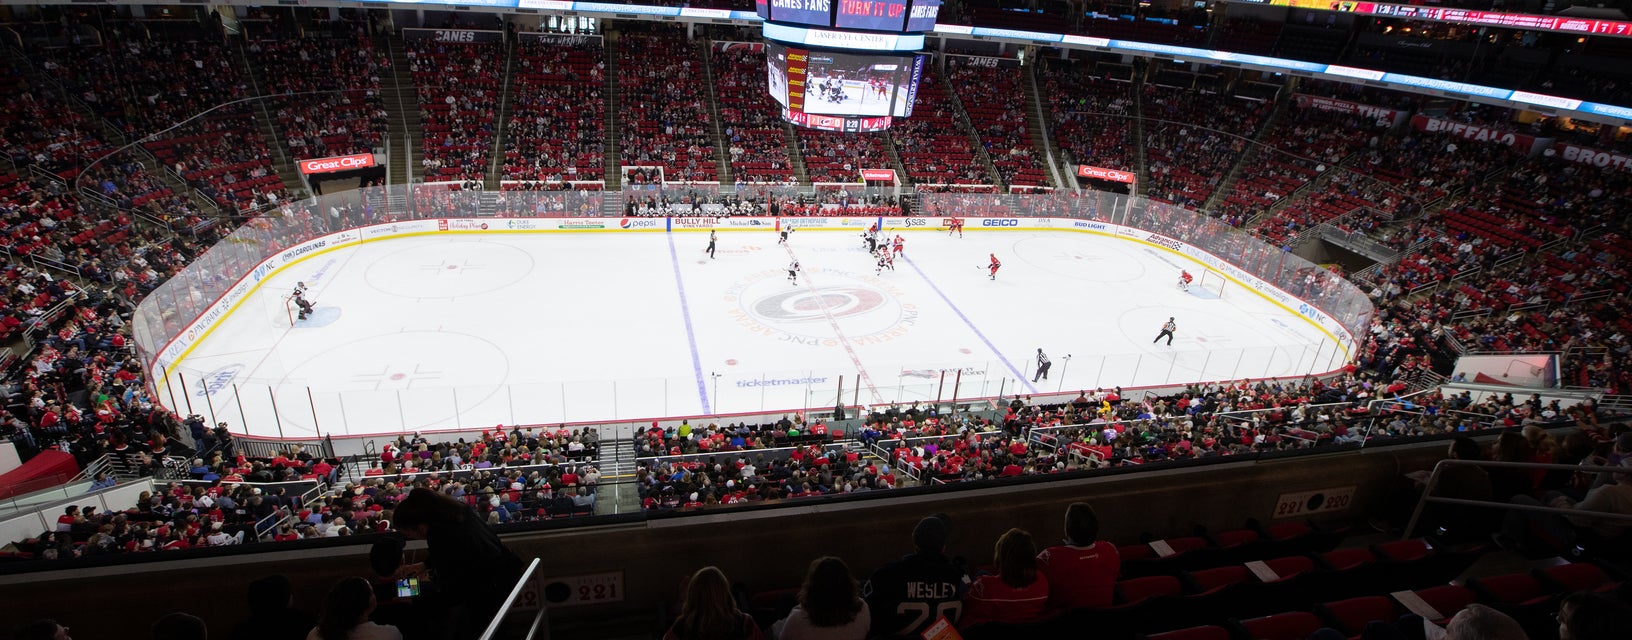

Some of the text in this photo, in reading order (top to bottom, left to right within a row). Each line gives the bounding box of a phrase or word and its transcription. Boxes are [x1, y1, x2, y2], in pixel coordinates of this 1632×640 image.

[772, 0, 829, 12] CANES FANS
[842, 0, 903, 18] TURN IT UP
[910, 5, 939, 19] CANES FANS
[434, 30, 475, 42] CANES
[814, 31, 884, 42] LASER EYE CENTER
[968, 56, 998, 68] CANES
[1358, 105, 1391, 119] THE
[1425, 118, 1516, 146] BUFFALO
[307, 156, 367, 171] Great Clips
[1083, 167, 1130, 181] Great Clips
[632, 219, 656, 228] pepsi
[703, 217, 721, 225] HILL
[911, 218, 926, 226] sas
[982, 219, 1018, 227] GEICO
[1150, 233, 1174, 245] Advance
[295, 240, 327, 256] CAROLINAS
[265, 260, 276, 271] NC
[1315, 312, 1328, 325] NC
[735, 376, 828, 388] ticketmaster
[1278, 500, 1304, 515] 221
[1325, 494, 1350, 509] 220
[579, 583, 617, 601] 221
[907, 581, 956, 599] WESLEY
